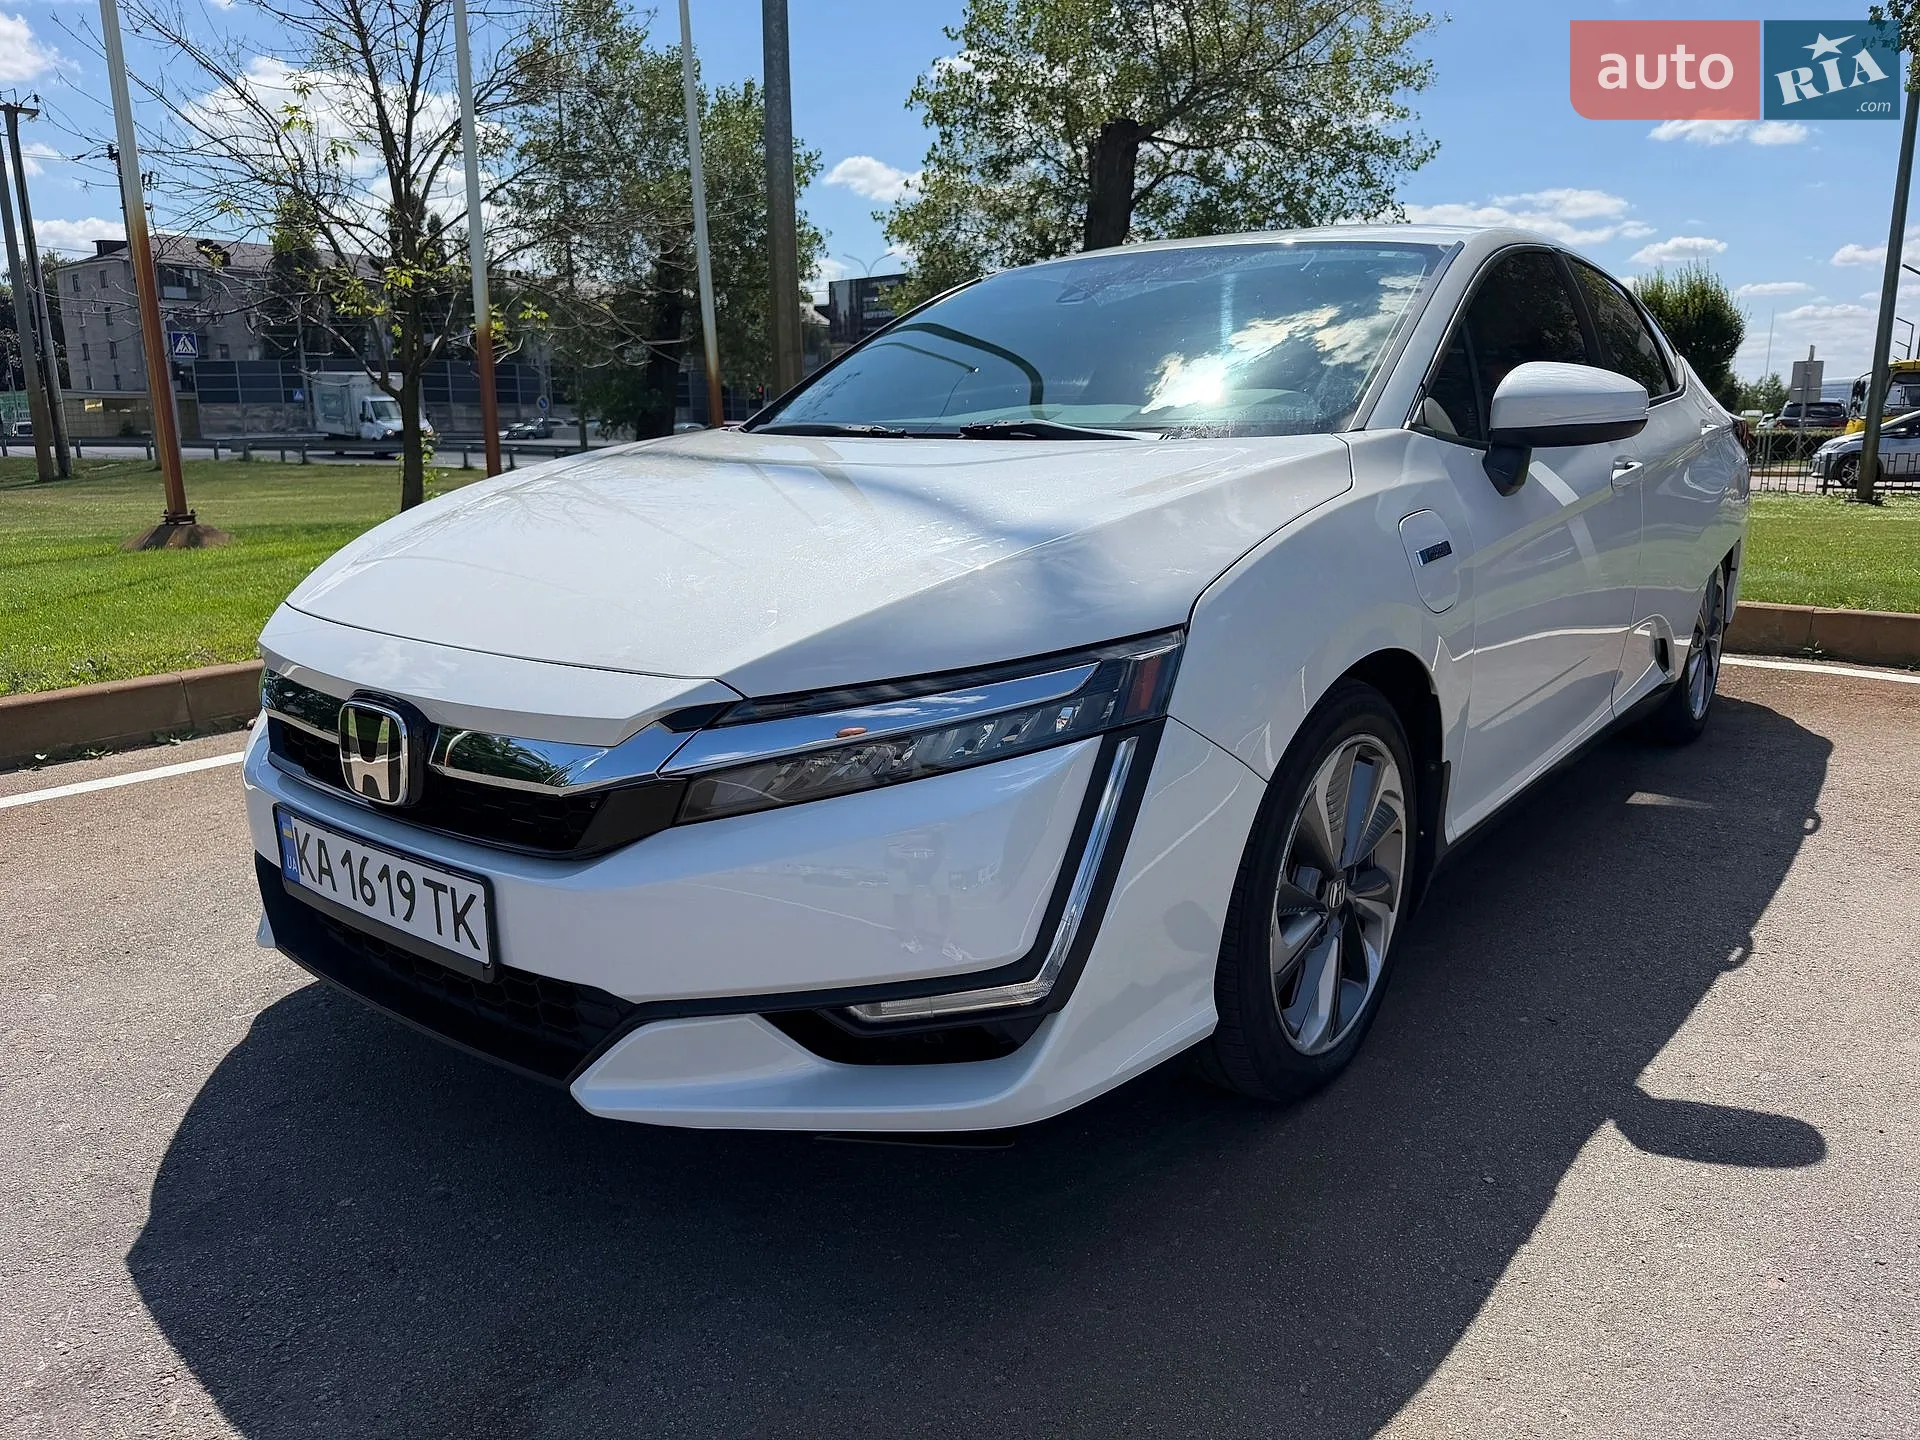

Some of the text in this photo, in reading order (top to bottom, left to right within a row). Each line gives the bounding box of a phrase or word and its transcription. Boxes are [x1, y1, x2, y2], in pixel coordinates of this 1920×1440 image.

[286, 854, 298, 873] UA
[293, 826, 481, 951] KA 1619 TK
